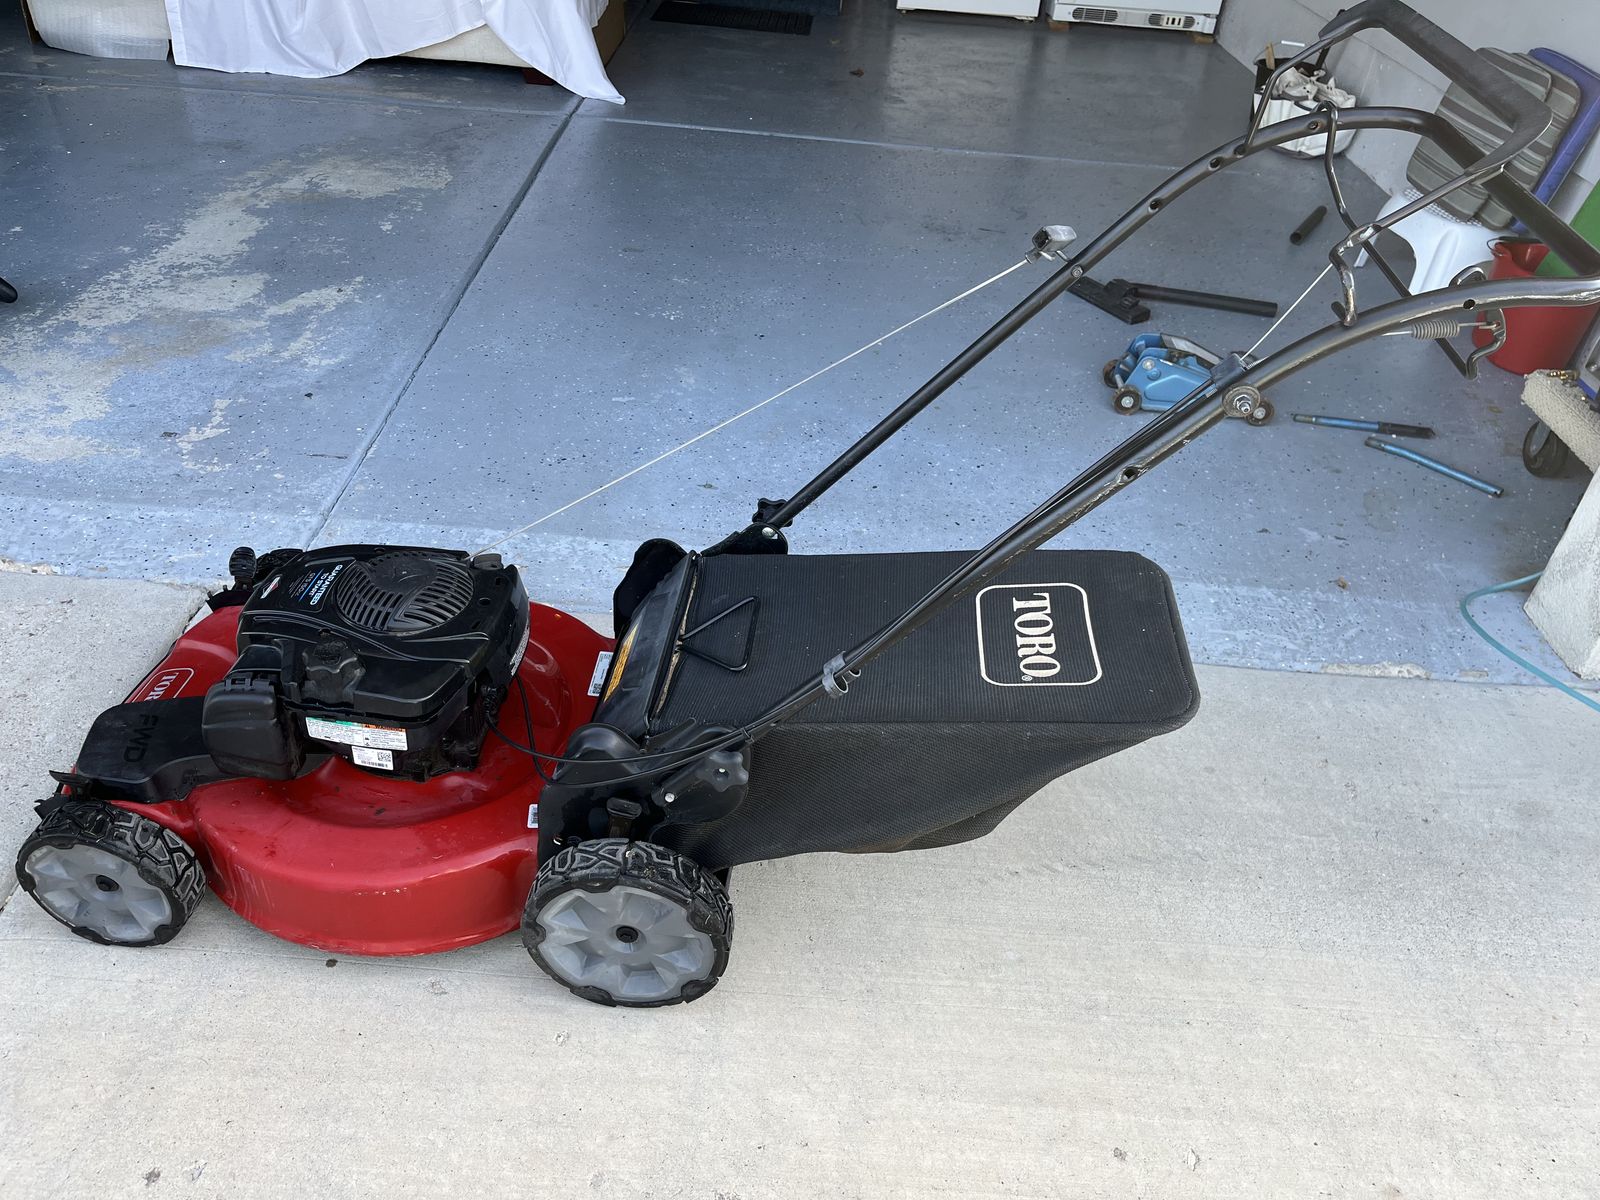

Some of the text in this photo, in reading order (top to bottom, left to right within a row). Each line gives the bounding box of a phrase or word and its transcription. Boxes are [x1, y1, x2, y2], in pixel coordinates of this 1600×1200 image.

[309, 564, 343, 605] GUARANTEED
[144, 672, 179, 701] TOR
[123, 713, 159, 762] FWD
